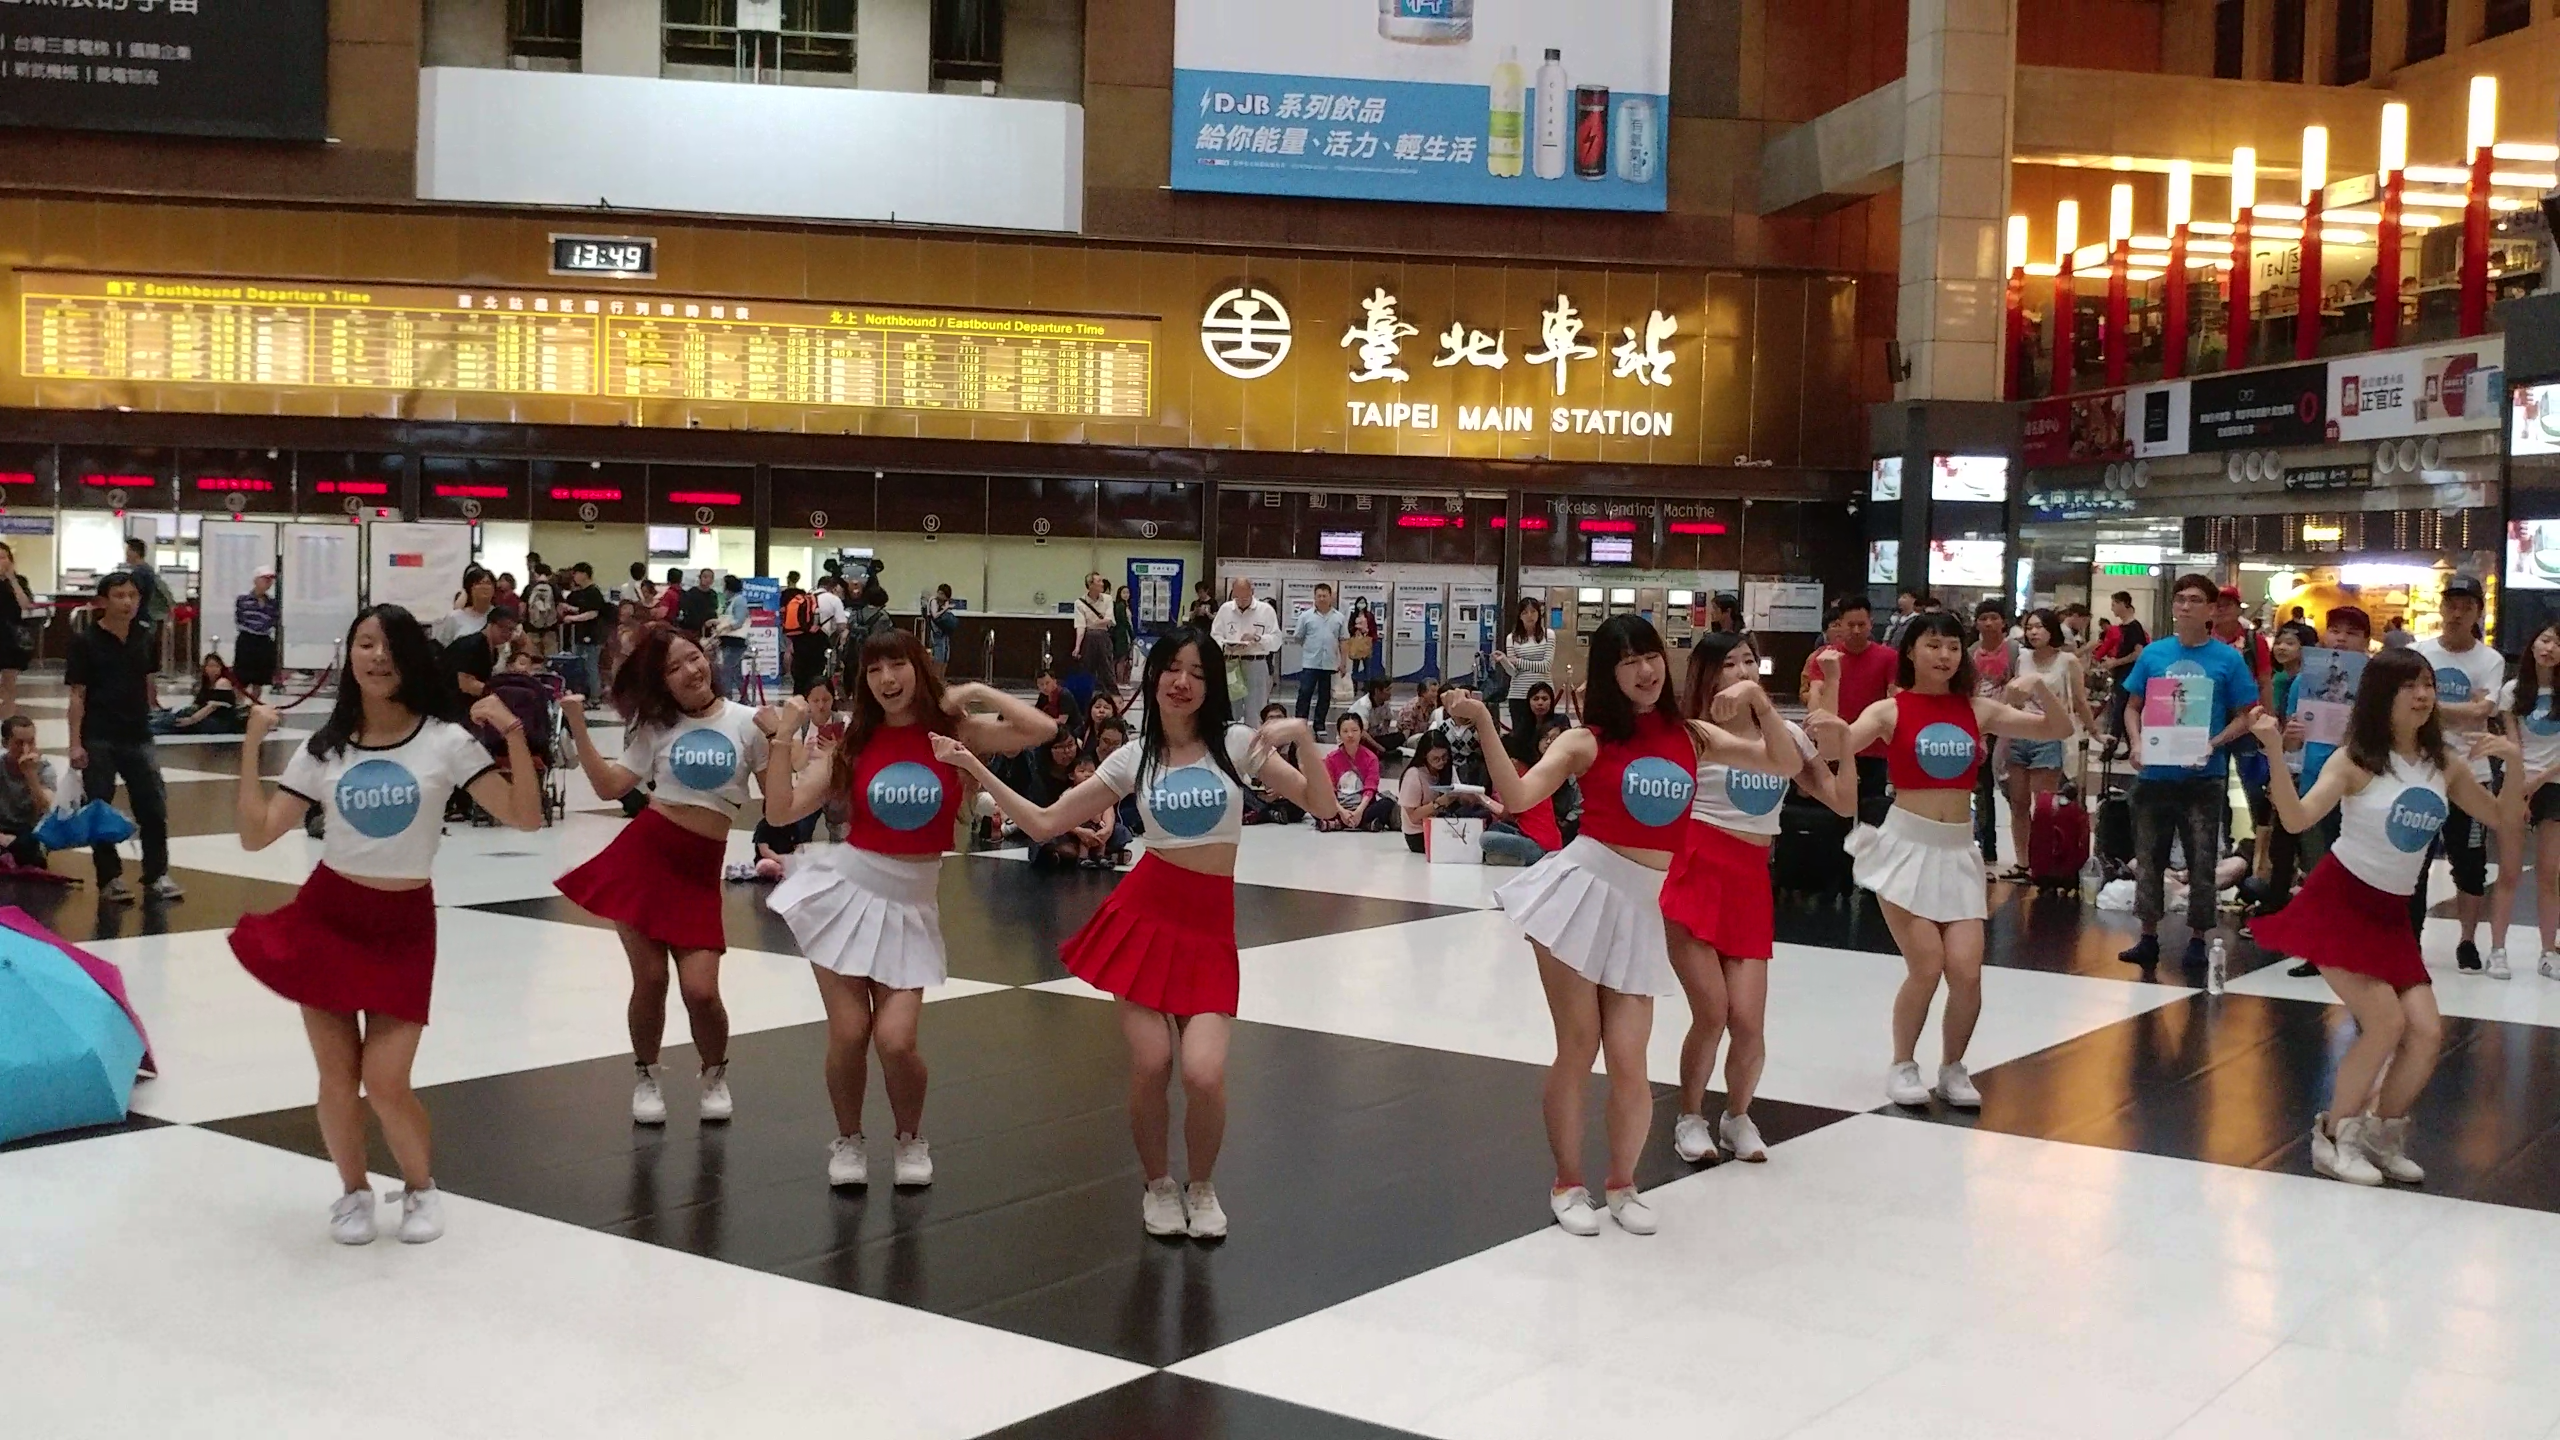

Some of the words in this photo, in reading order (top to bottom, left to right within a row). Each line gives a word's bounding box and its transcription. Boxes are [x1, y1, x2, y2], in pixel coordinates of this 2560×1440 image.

[1213, 92, 1271, 115] DJB
[1275, 93, 1387, 124] 系列飲品
[1196, 123, 1477, 163] 給你能量、活力、輕生活
[572, 245, 641, 269] 13:49
[144, 283, 241, 298] Southbound
[246, 287, 327, 303] Departure
[333, 290, 371, 303] Time
[829, 312, 858, 324] 北上
[865, 313, 937, 328] Northbound
[947, 317, 1011, 331] Eastbound
[1014, 321, 1073, 336] Departure
[1076, 324, 1105, 336] Time
[1341, 287, 1678, 396] 臺北車站
[2360, 387, 2404, 411] 正官庄
[1347, 401, 1438, 430] TAIPEI
[1458, 405, 1533, 433] MAIN
[1551, 407, 1674, 437] STATION
[1263, 491, 1465, 514] 自動售票機
[1546, 499, 1596, 516] Tickets
[1603, 501, 1655, 518] Vending
[1663, 503, 1715, 518] Machine
[2436, 680, 2470, 697] ooter
[673, 746, 735, 767] Footer
[1920, 738, 1975, 757] Footer
[1627, 772, 1691, 799] Footer
[1730, 769, 1785, 790] Footer
[339, 783, 417, 810] Footer
[873, 782, 940, 805] Footer
[1153, 786, 1225, 810] Footer
[2391, 807, 2444, 832] Footer
